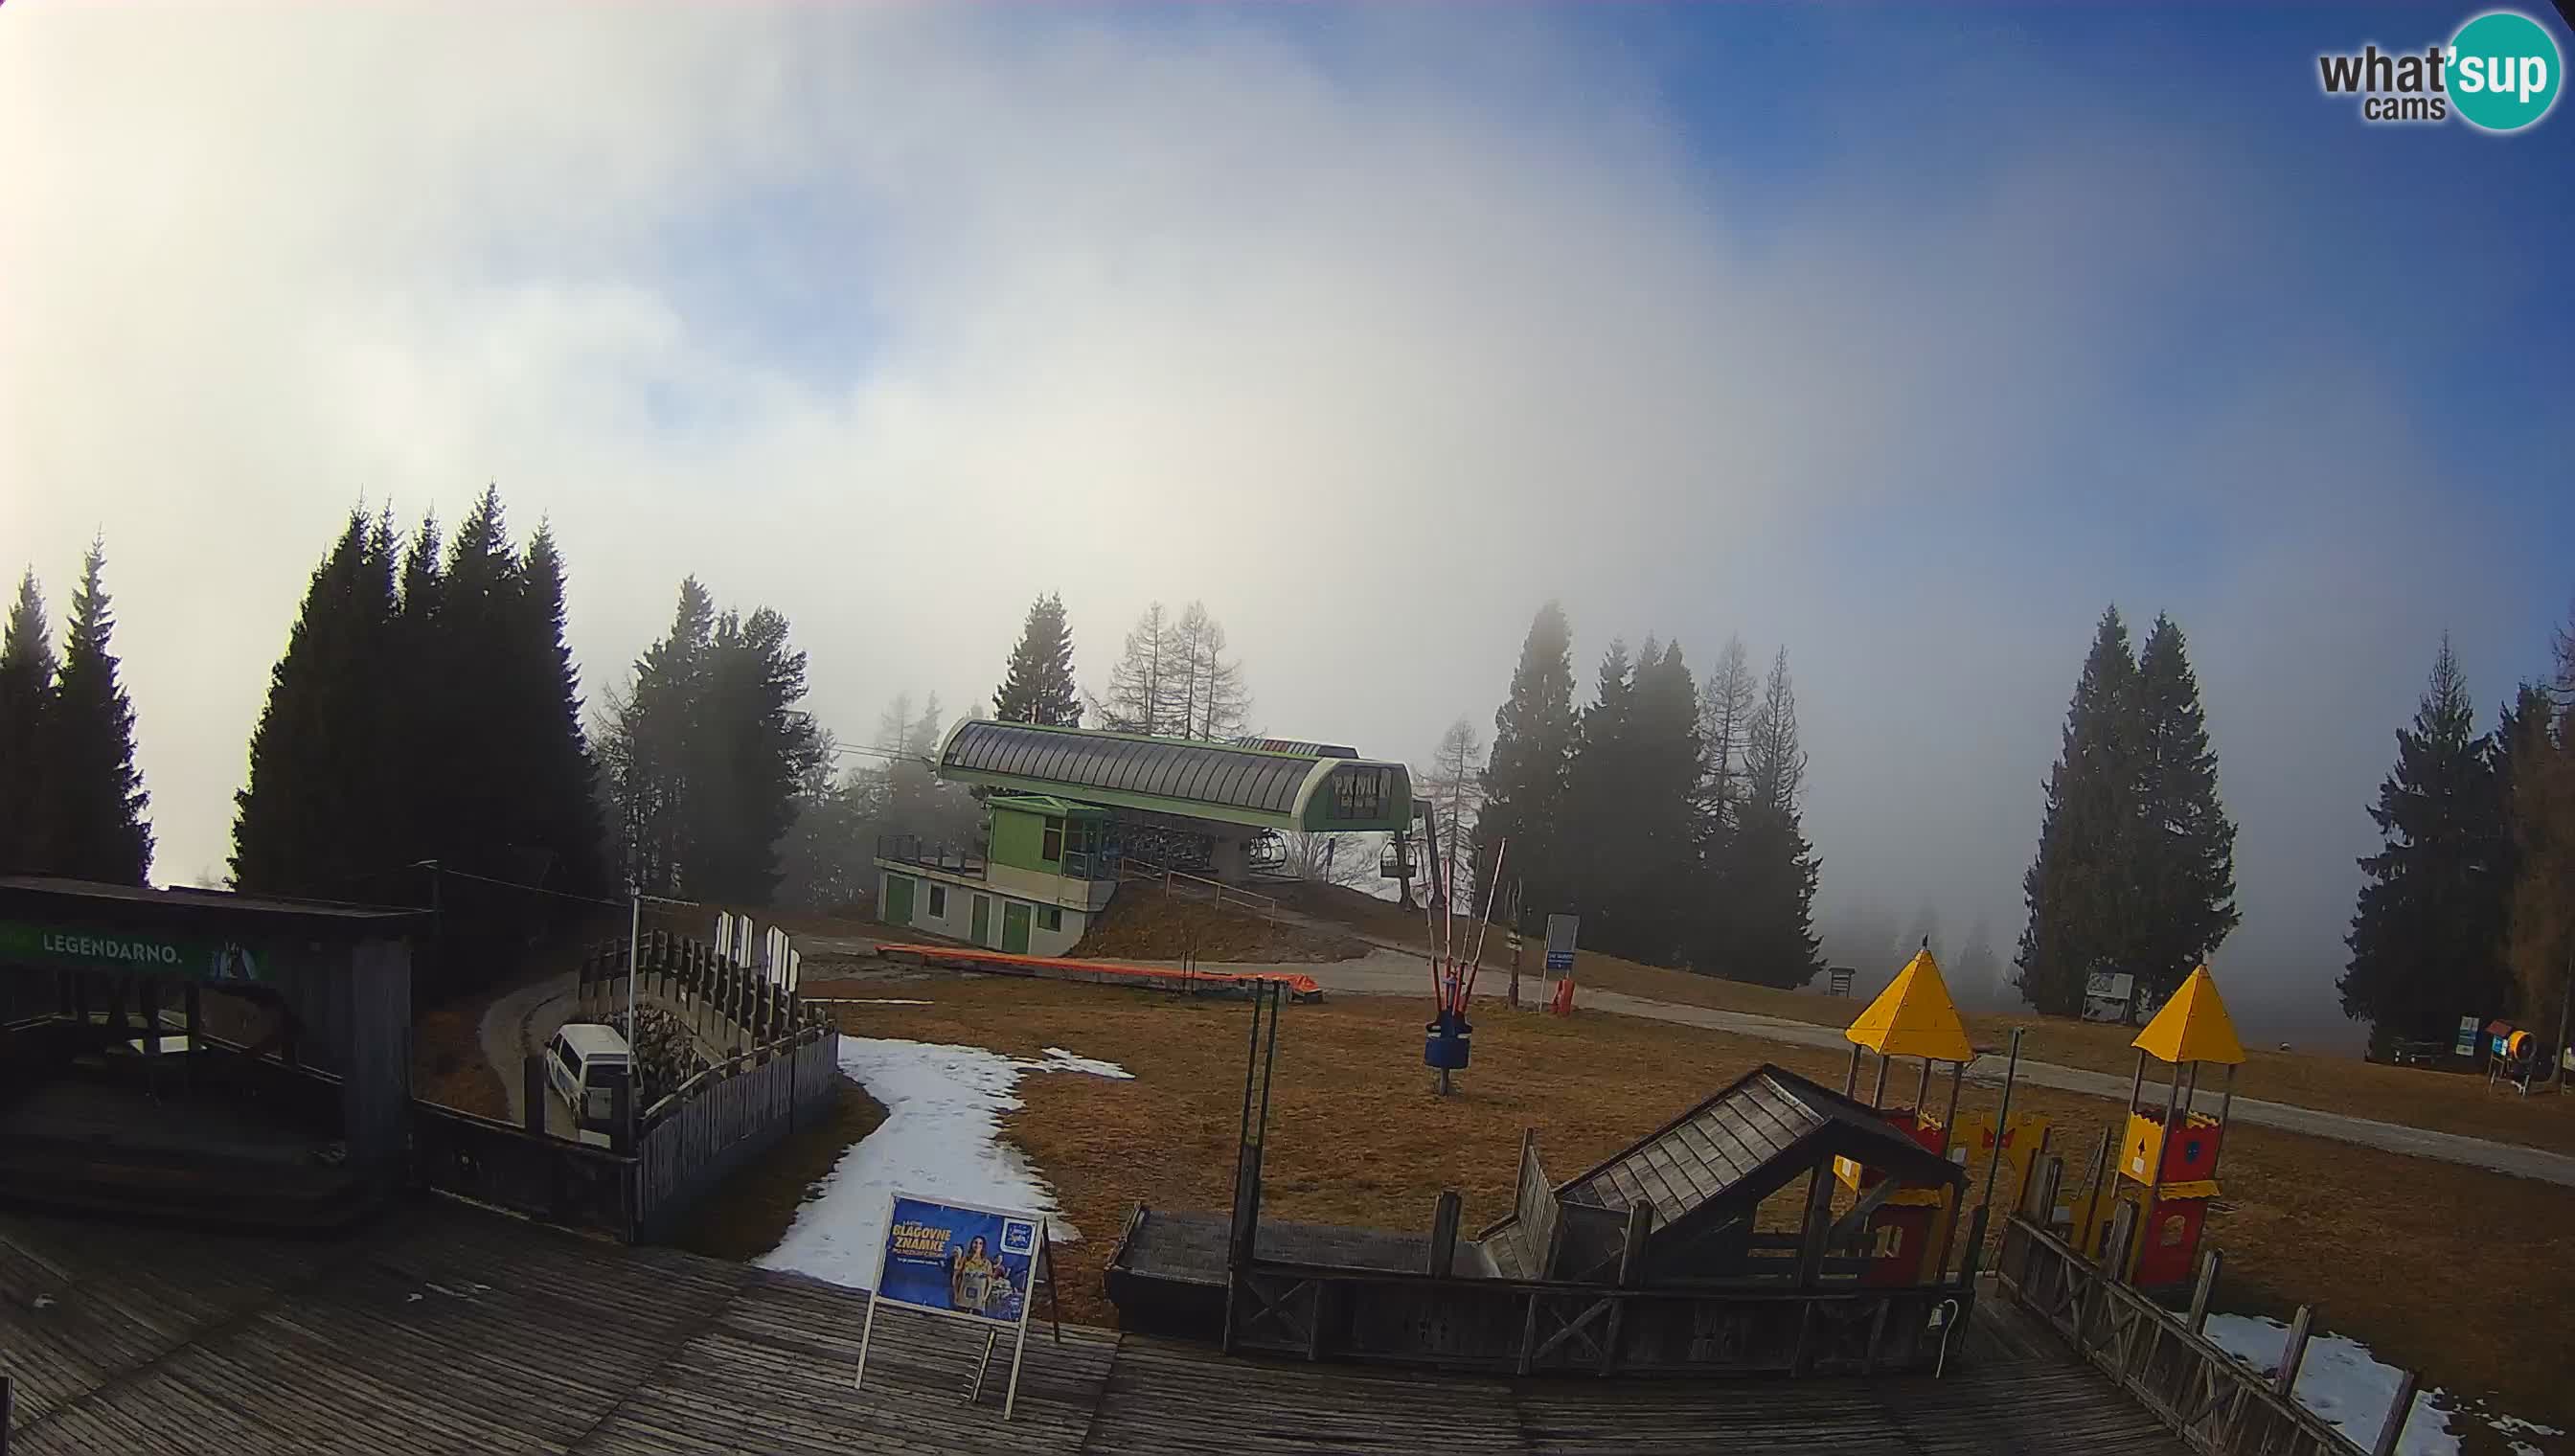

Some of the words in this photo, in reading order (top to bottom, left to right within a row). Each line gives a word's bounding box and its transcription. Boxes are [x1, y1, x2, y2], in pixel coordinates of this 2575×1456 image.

[43, 933, 183, 965] LEGENDARNO.
[892, 1224, 952, 1241] BLAGOVNE
[895, 1237, 946, 1252] ZNAMKE
